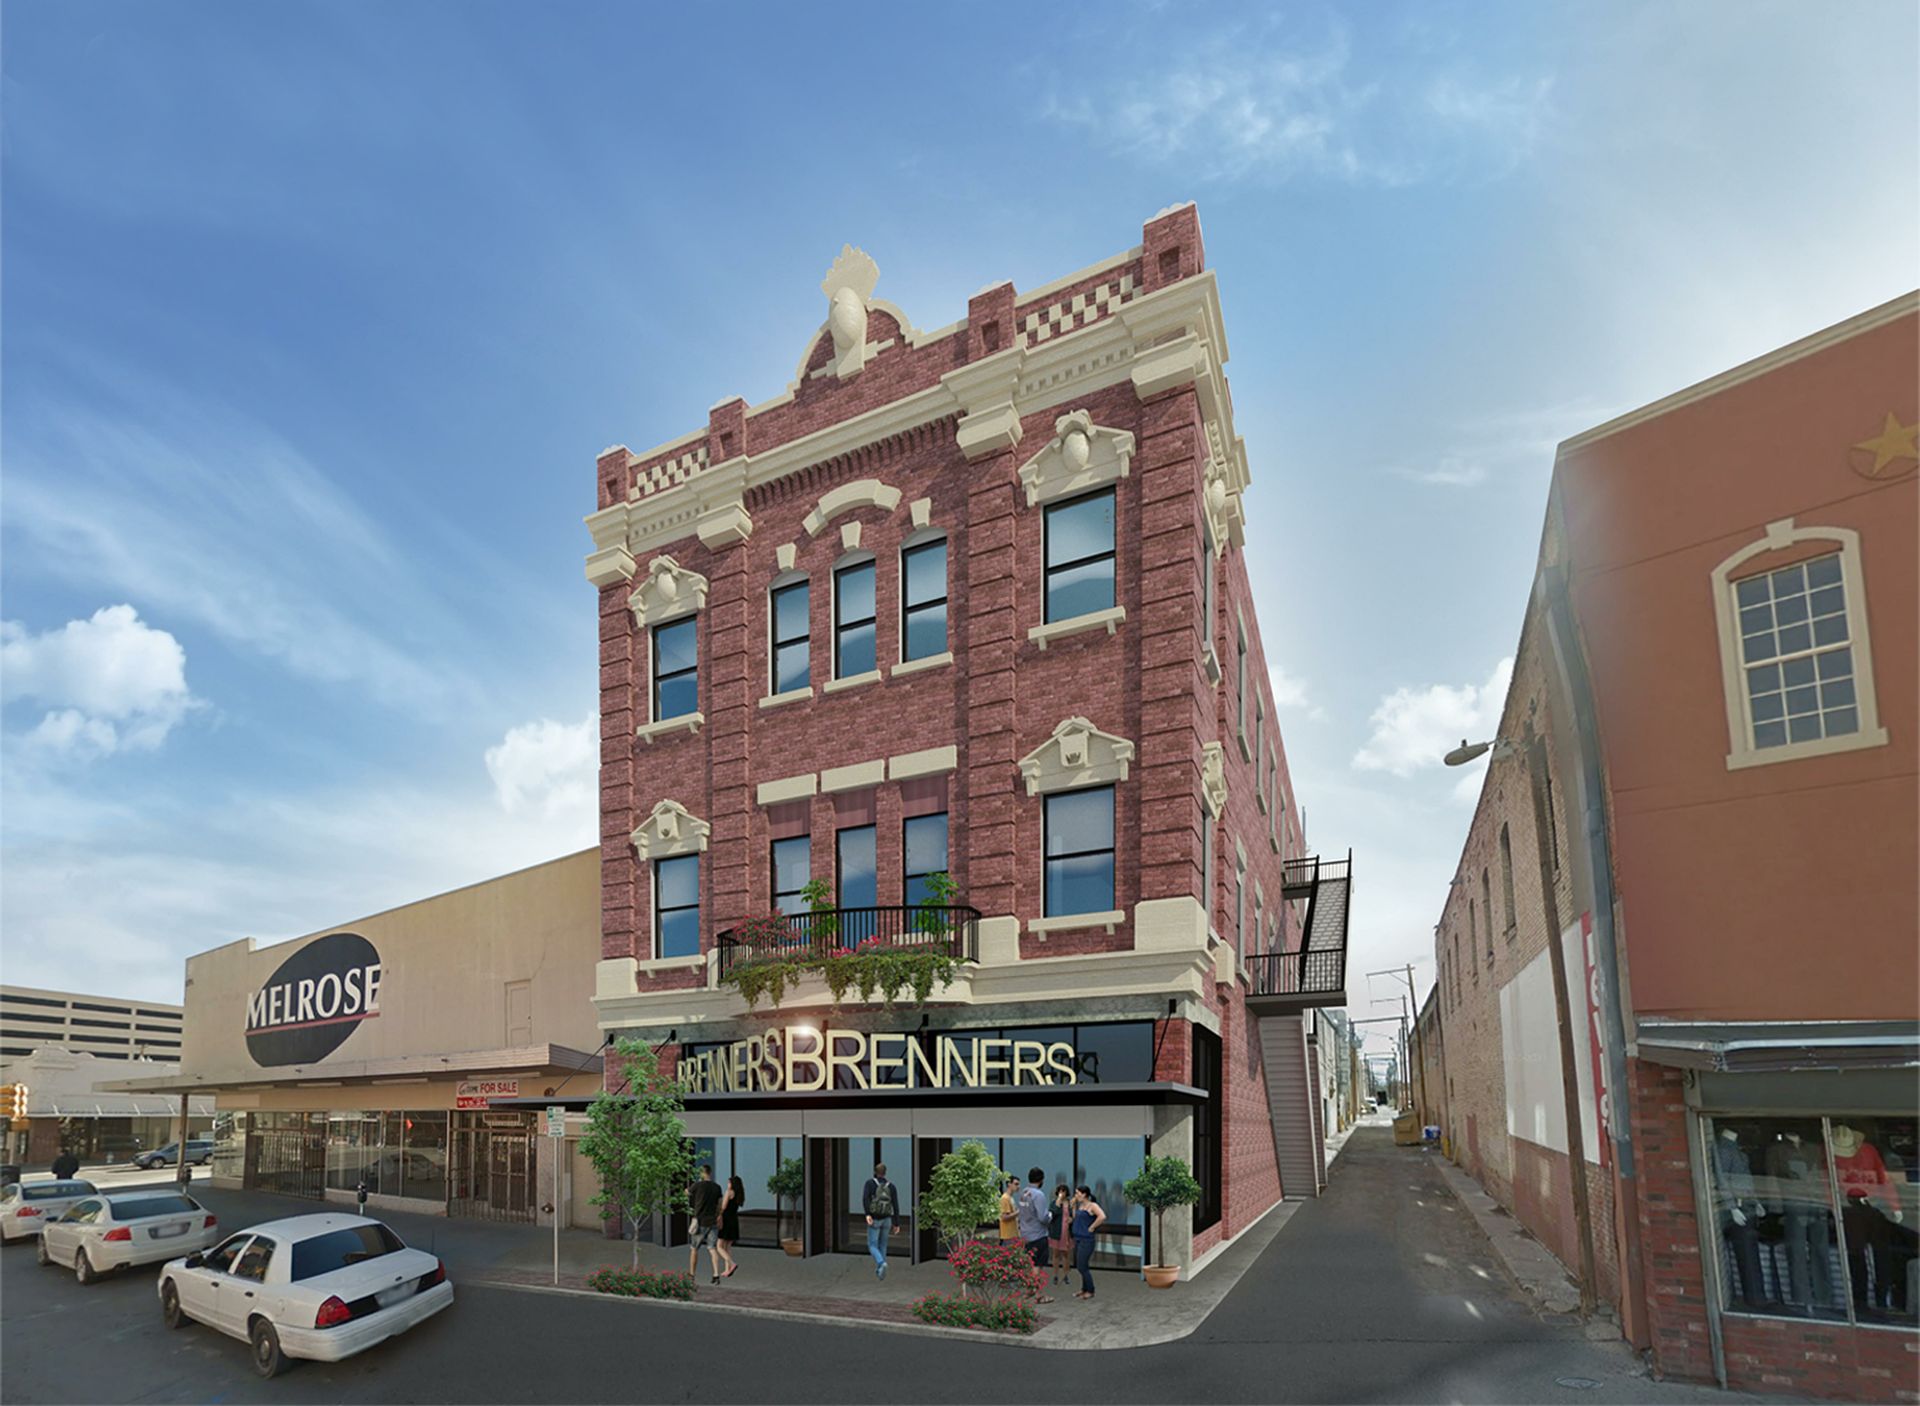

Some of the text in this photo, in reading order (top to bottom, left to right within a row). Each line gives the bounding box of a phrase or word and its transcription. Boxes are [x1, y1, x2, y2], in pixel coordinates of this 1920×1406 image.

[245, 964, 381, 1029] MELROSE
[480, 1082, 496, 1094] FOR
[497, 1081, 517, 1093] SALE
[677, 1027, 784, 1093] BRENNERS
[785, 1025, 1076, 1092] BRENNERS
